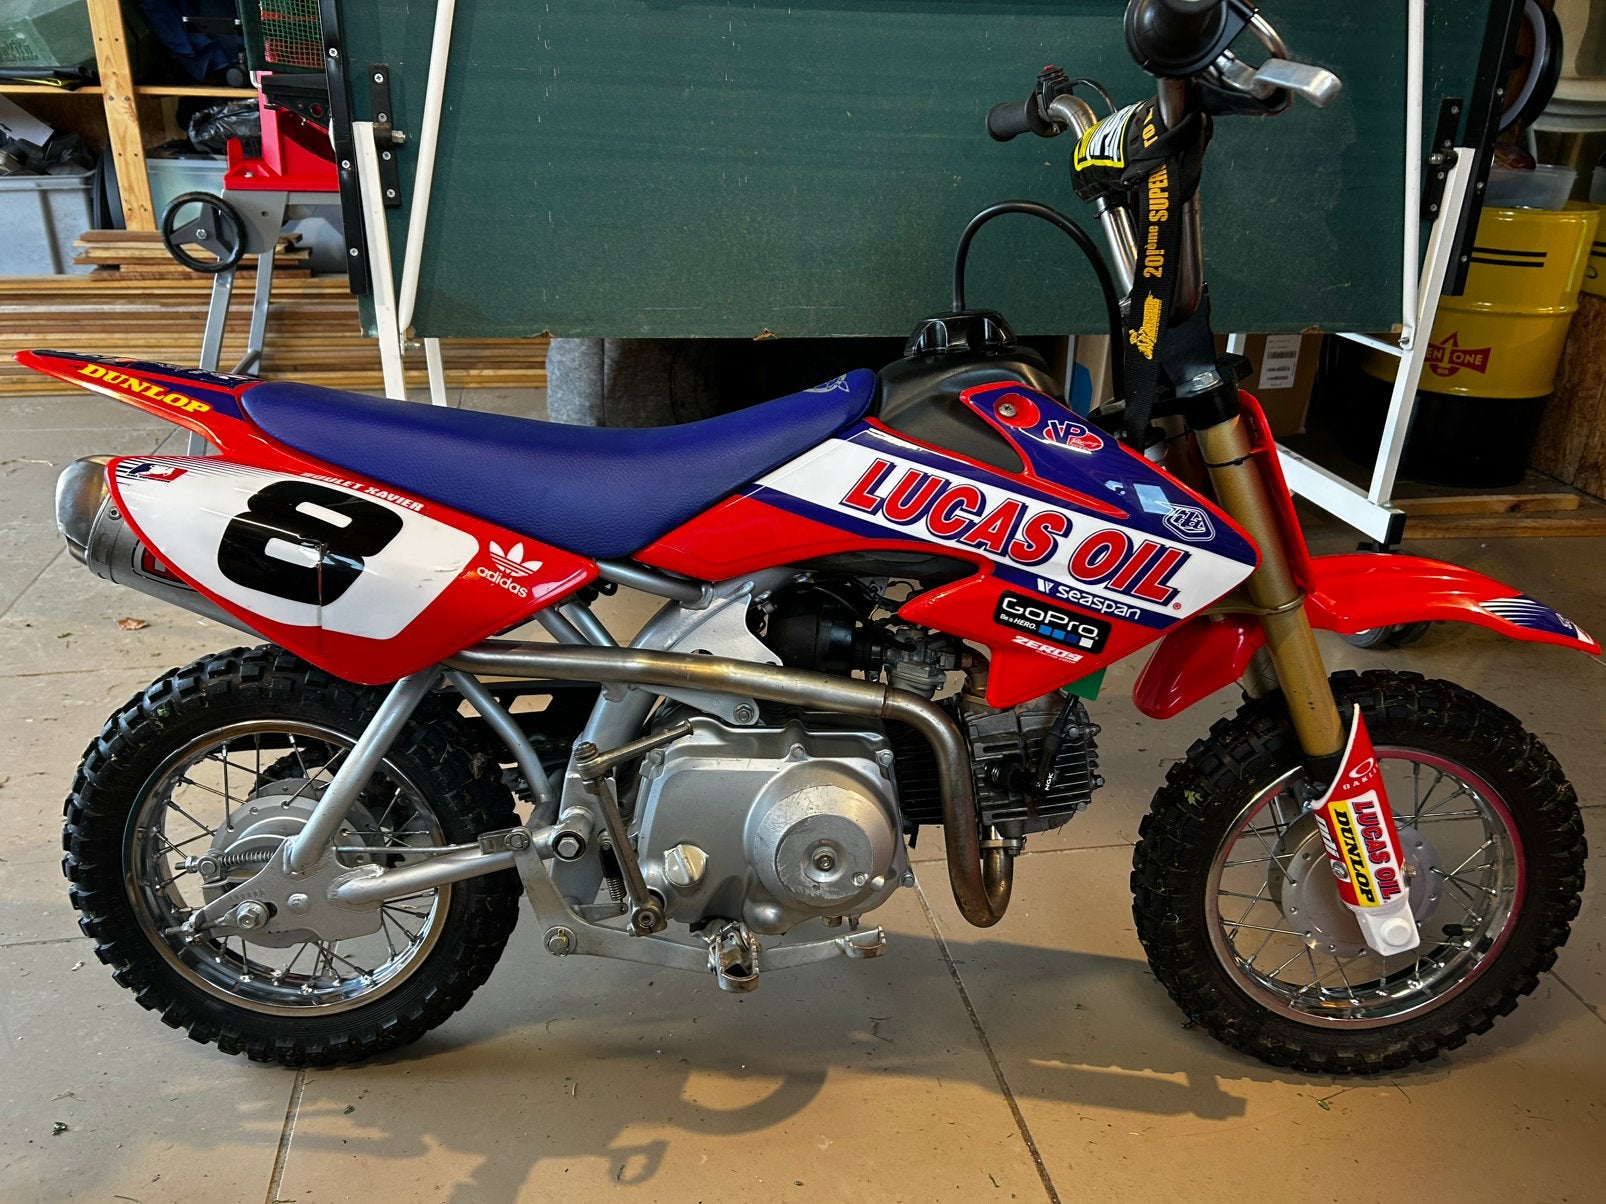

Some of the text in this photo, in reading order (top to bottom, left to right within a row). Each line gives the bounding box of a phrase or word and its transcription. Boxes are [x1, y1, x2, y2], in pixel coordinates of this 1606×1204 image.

[1452, 352, 1483, 365] ONE
[77, 363, 213, 413] DUNLOP
[1048, 420, 1089, 446] VP
[364, 486, 425, 512] XAVIER
[217, 480, 404, 607] 8
[839, 457, 1192, 608] LUCAS OIL
[477, 566, 528, 598] adidas
[1001, 597, 1099, 638] GoPro
[1056, 585, 1141, 620] seaspan
[1044, 772, 1053, 790] NGK
[1342, 763, 1379, 790] OAKL
[1334, 808, 1376, 904] DUNLOP
[1352, 800, 1402, 900] LUCAS OIL
